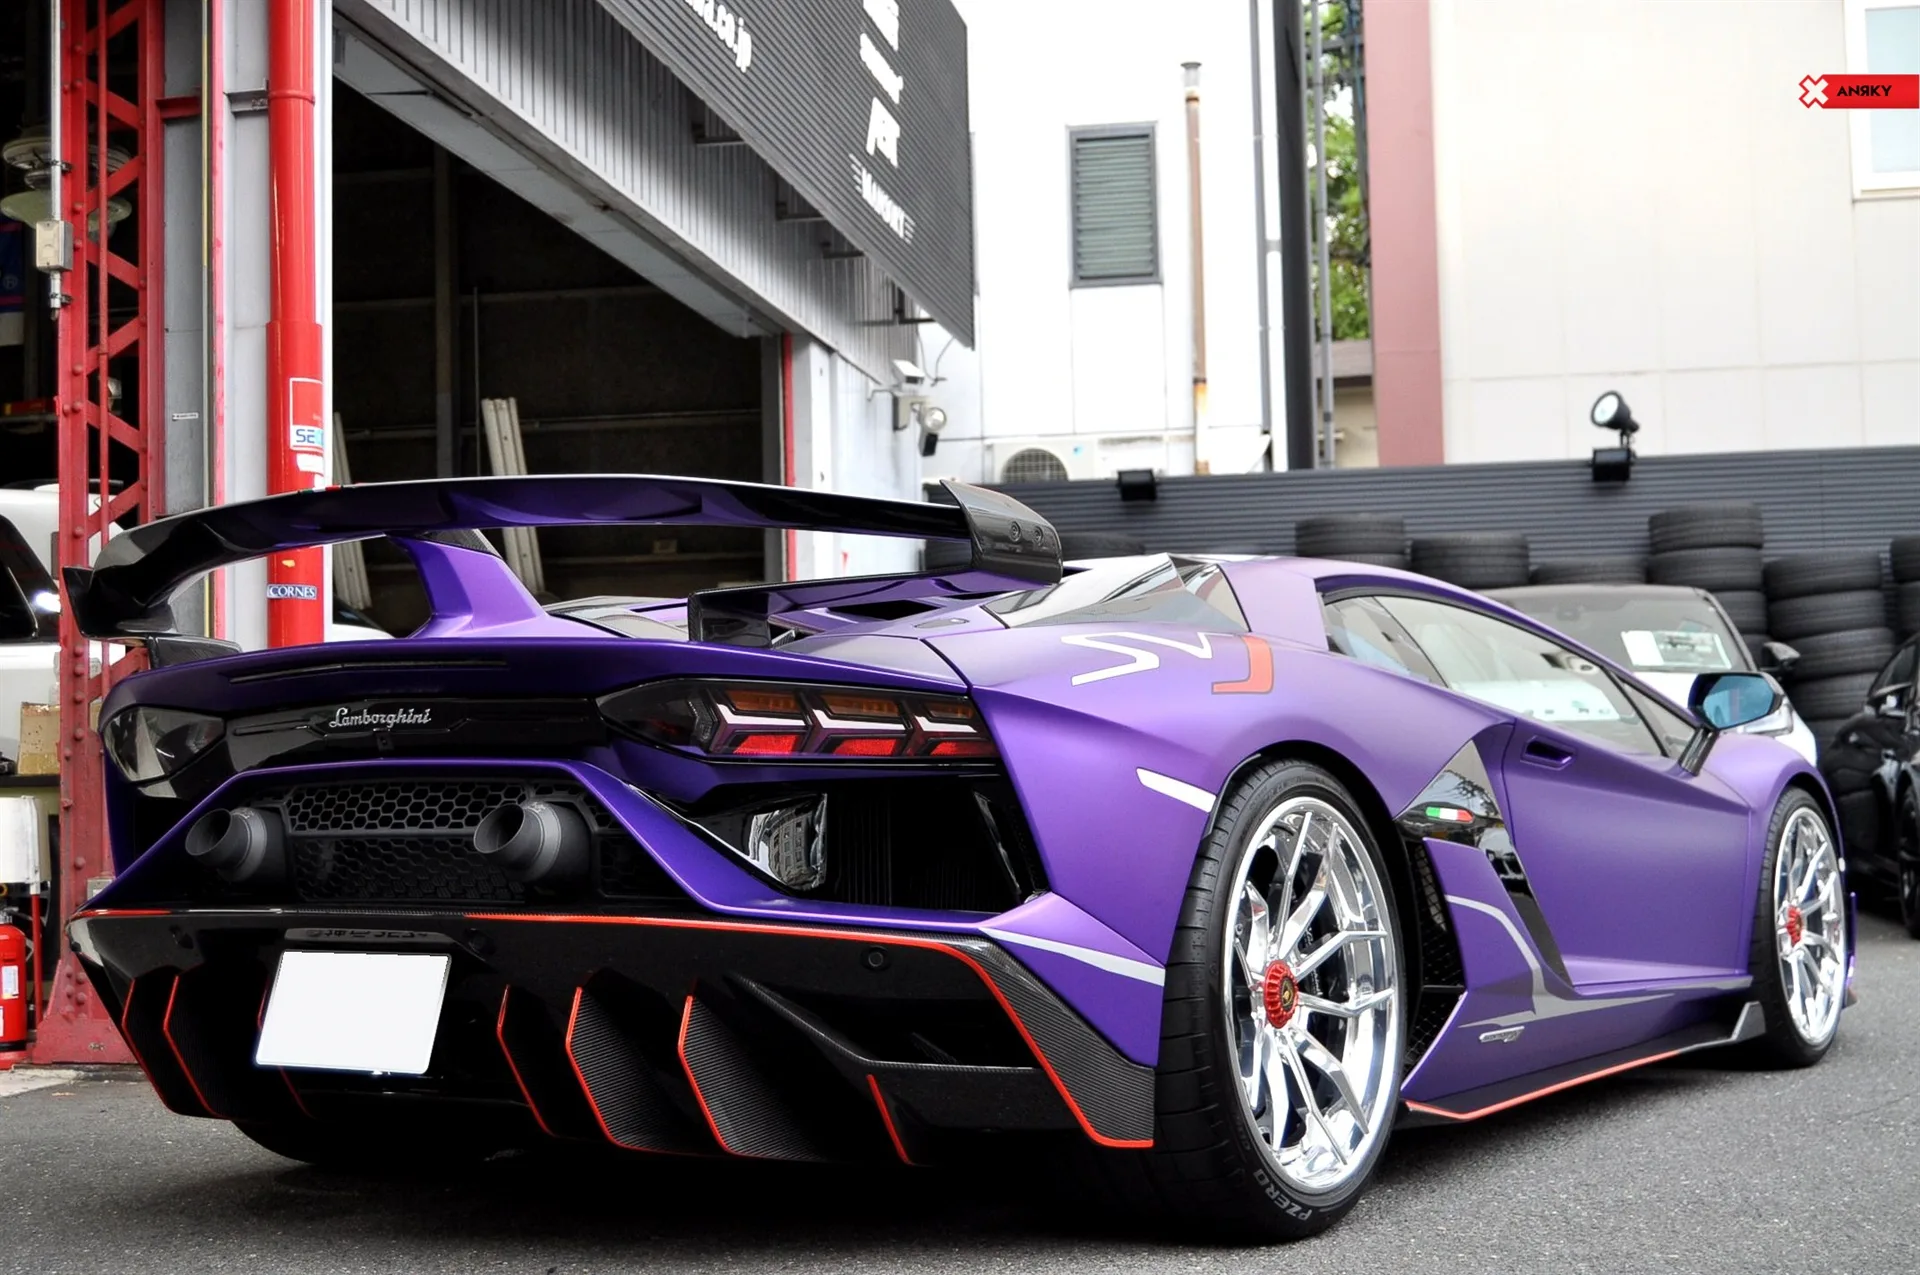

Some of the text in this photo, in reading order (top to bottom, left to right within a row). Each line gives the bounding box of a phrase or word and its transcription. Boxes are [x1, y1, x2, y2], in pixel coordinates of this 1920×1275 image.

[296, 429, 323, 444] SE
[270, 586, 315, 598] CORNES
[329, 707, 431, 728] Lamborghini
